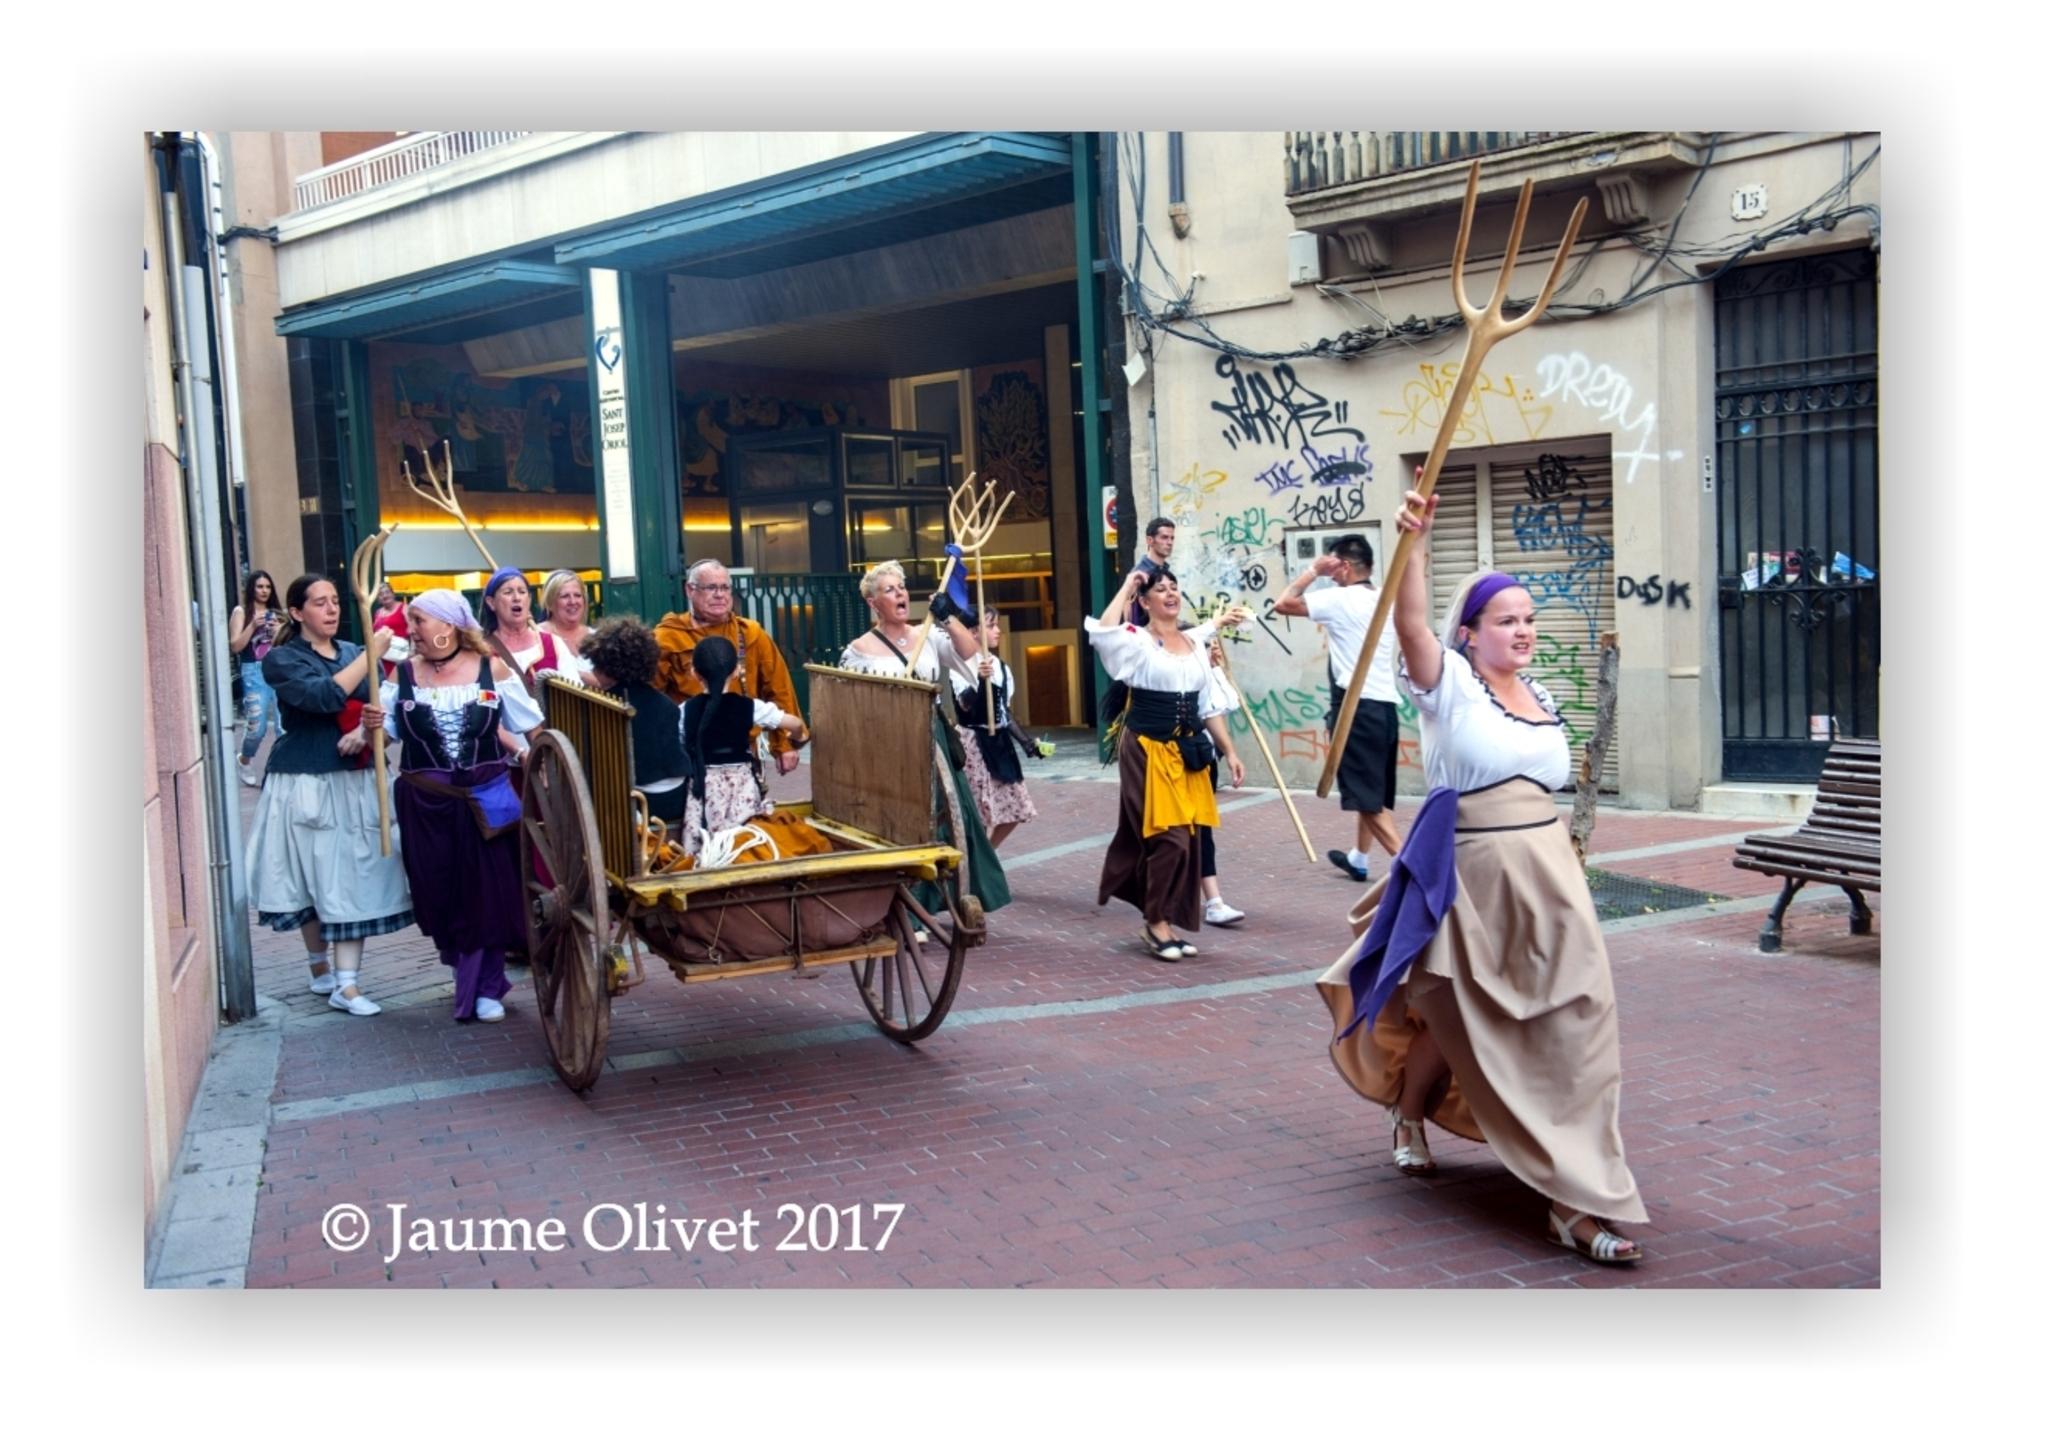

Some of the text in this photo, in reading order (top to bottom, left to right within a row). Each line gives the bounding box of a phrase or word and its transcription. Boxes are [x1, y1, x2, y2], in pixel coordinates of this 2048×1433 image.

[1741, 191, 1760, 211] 15
[602, 408, 623, 420] SANT
[603, 422, 625, 438] JOSEP
[602, 438, 628, 451] ORIOL
